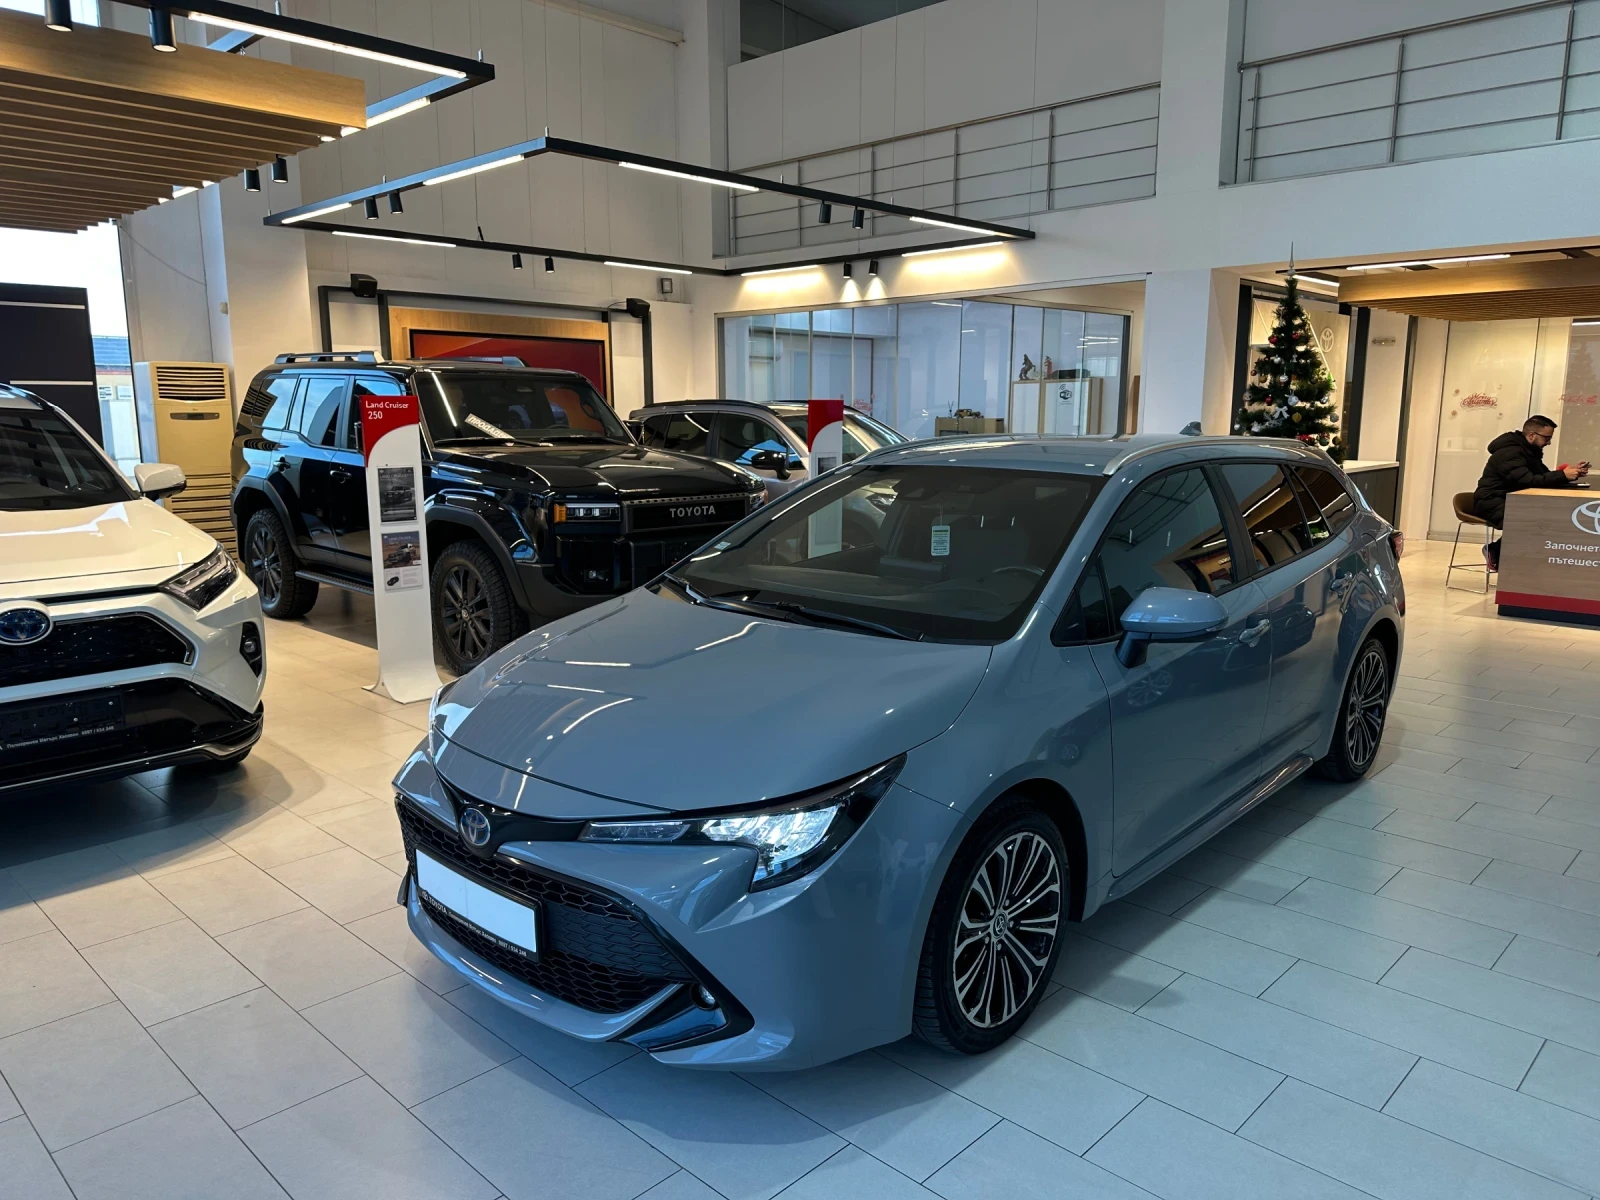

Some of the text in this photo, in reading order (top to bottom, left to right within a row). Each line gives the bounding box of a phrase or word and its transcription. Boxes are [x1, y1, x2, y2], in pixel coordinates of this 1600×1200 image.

[365, 400, 409, 409] Land Cruiser
[367, 410, 383, 420] 250
[669, 505, 716, 518] TOYOTA
[429, 896, 447, 914] TOYOTA
